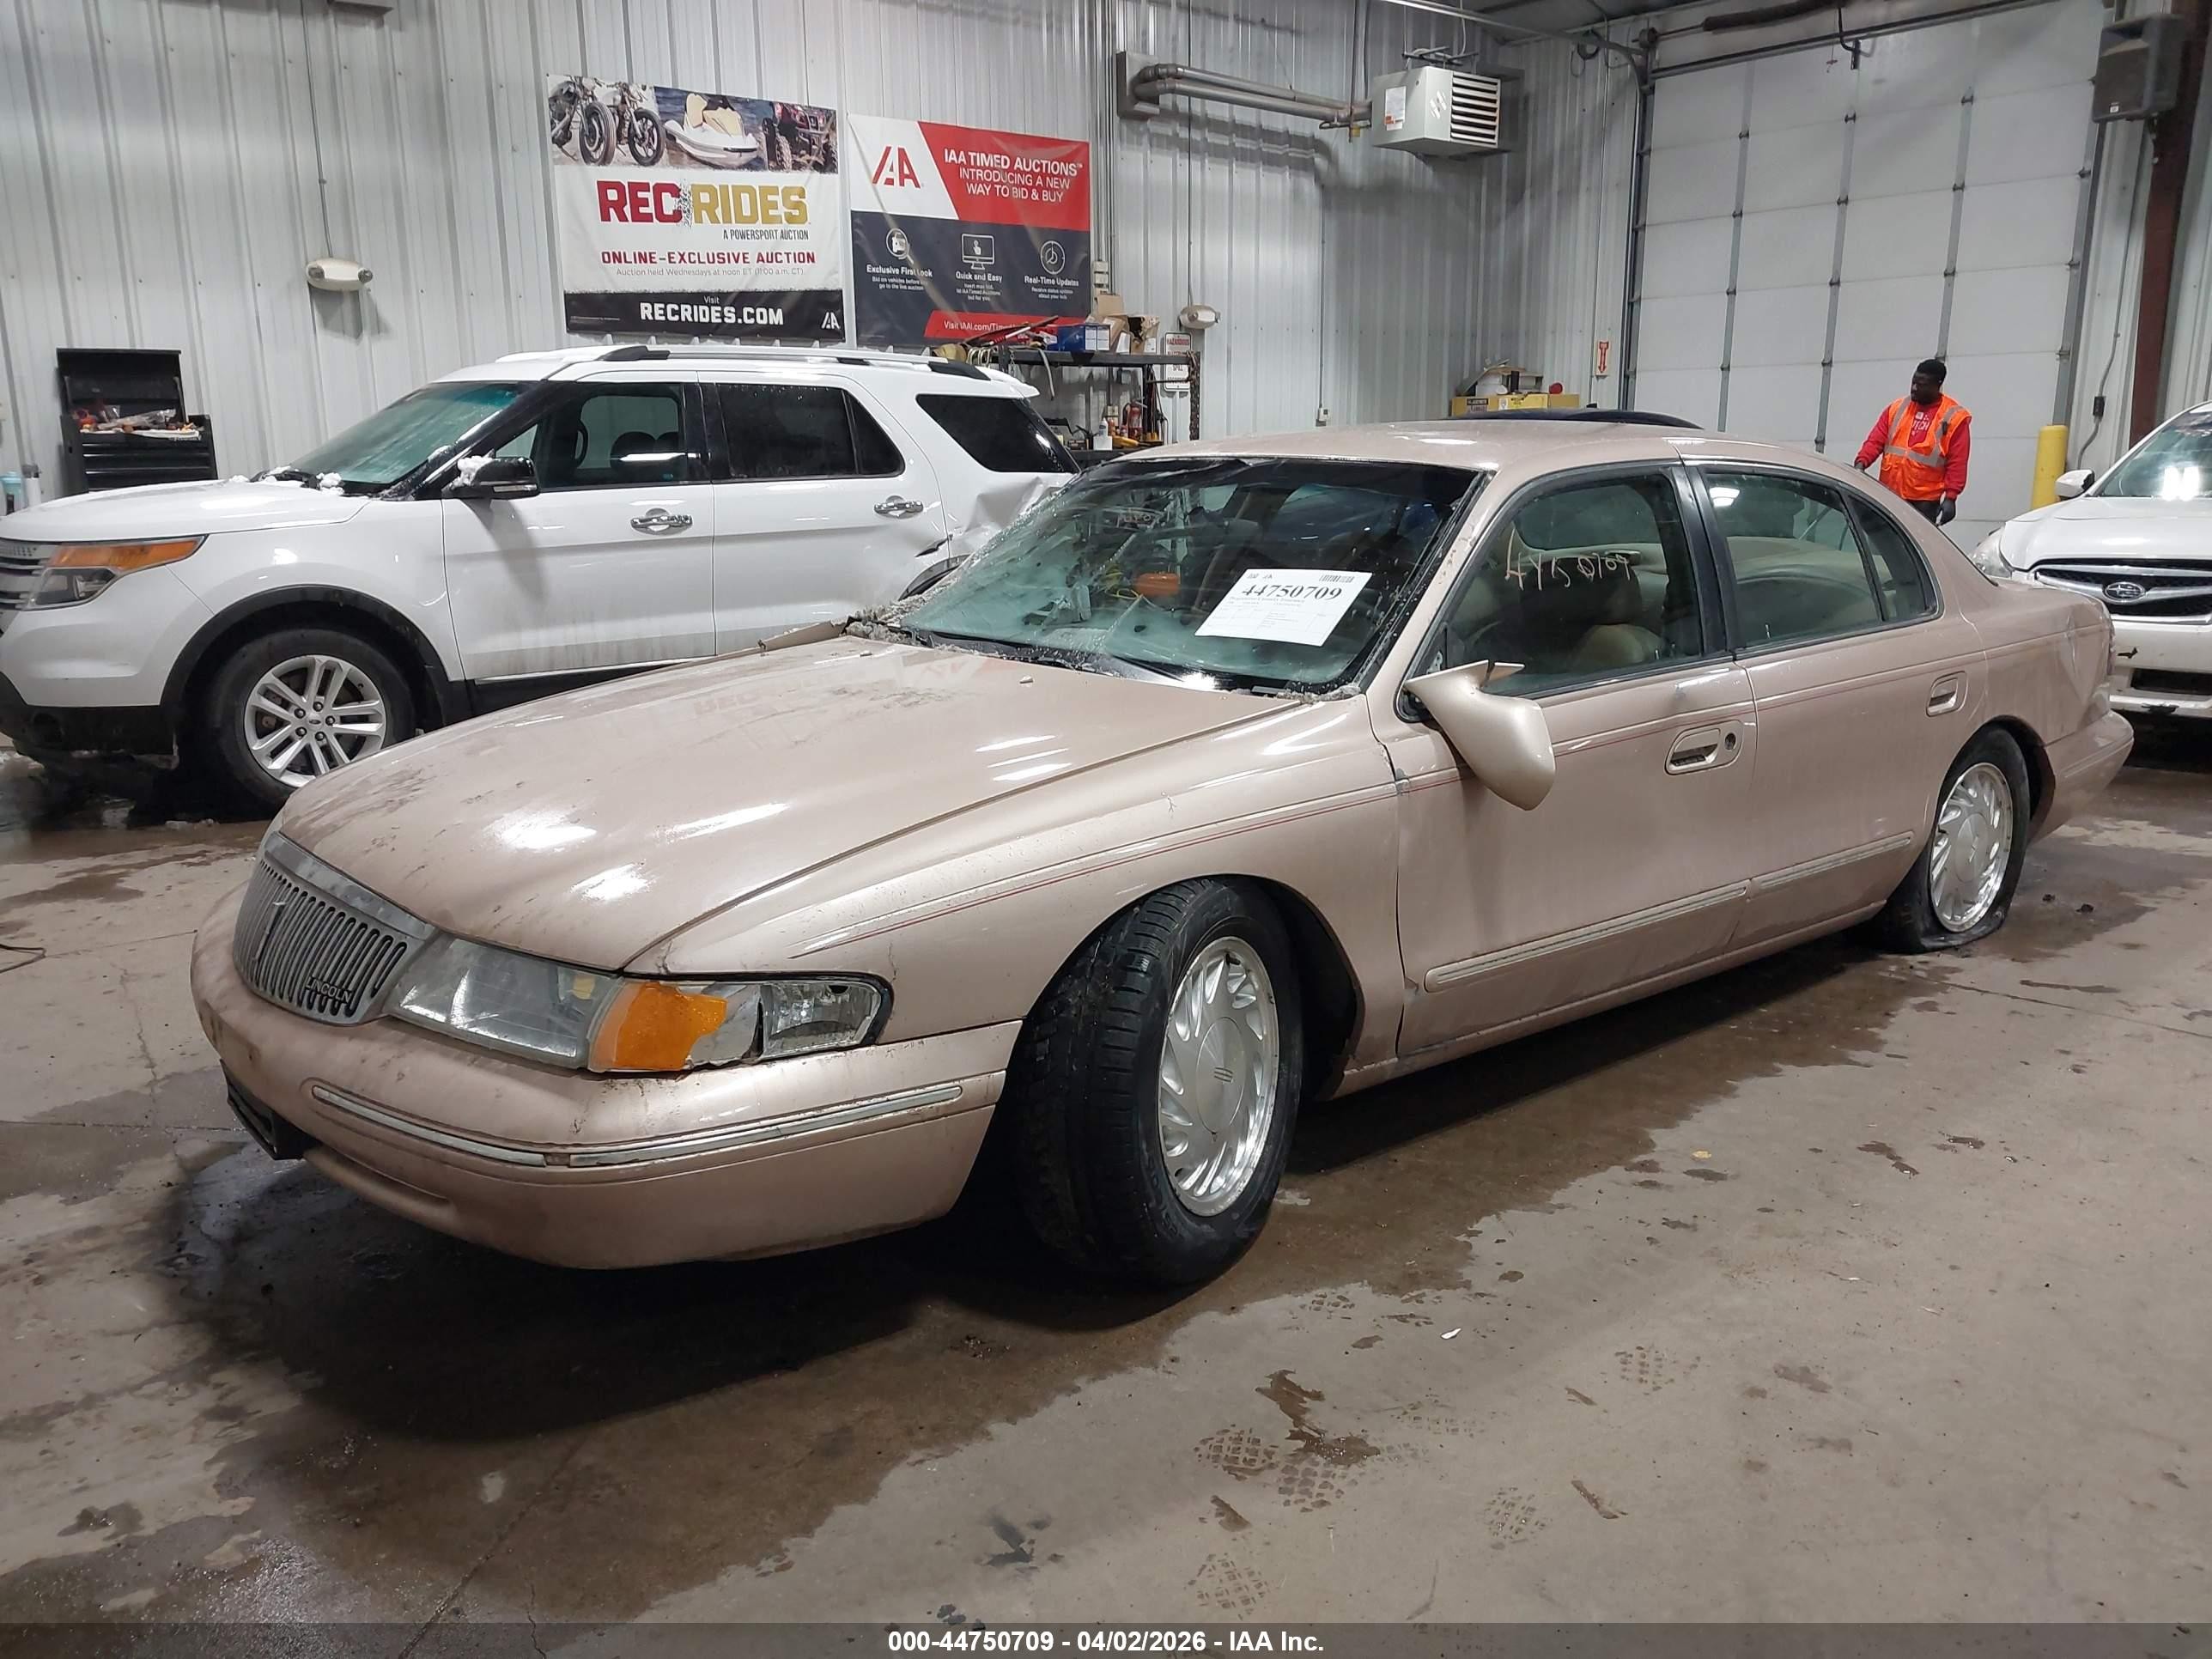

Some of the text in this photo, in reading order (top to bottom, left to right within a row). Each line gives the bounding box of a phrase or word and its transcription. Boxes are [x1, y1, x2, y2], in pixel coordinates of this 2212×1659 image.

[945, 149, 967, 164] IAA
[968, 152, 1010, 169] TIMED
[959, 167, 1070, 189] INTRODUCING A NEW
[967, 184, 1064, 203] WAY TO BID & BUY
[723, 229, 809, 240] A POWERSPORT AUCTION
[602, 251, 816, 264] ONLINE-EXCLUSIVE AUCTION
[617, 267, 645, 276] Auction
[647, 268, 664, 276] held
[666, 268, 712, 276] Wednesdays
[866, 264, 899, 274] Exclusive
[901, 266, 915, 275] First
[956, 270, 972, 280] Quick
[988, 273, 1002, 283] Easy
[1024, 276, 1079, 287] Real-Time Updates
[703, 295, 720, 304] Visit
[640, 302, 784, 325] RECRIDES.COM
[944, 320, 958, 329] Visit
[1242, 584, 1343, 601] 44750709
[305, 975, 352, 1003] LINCOLN
